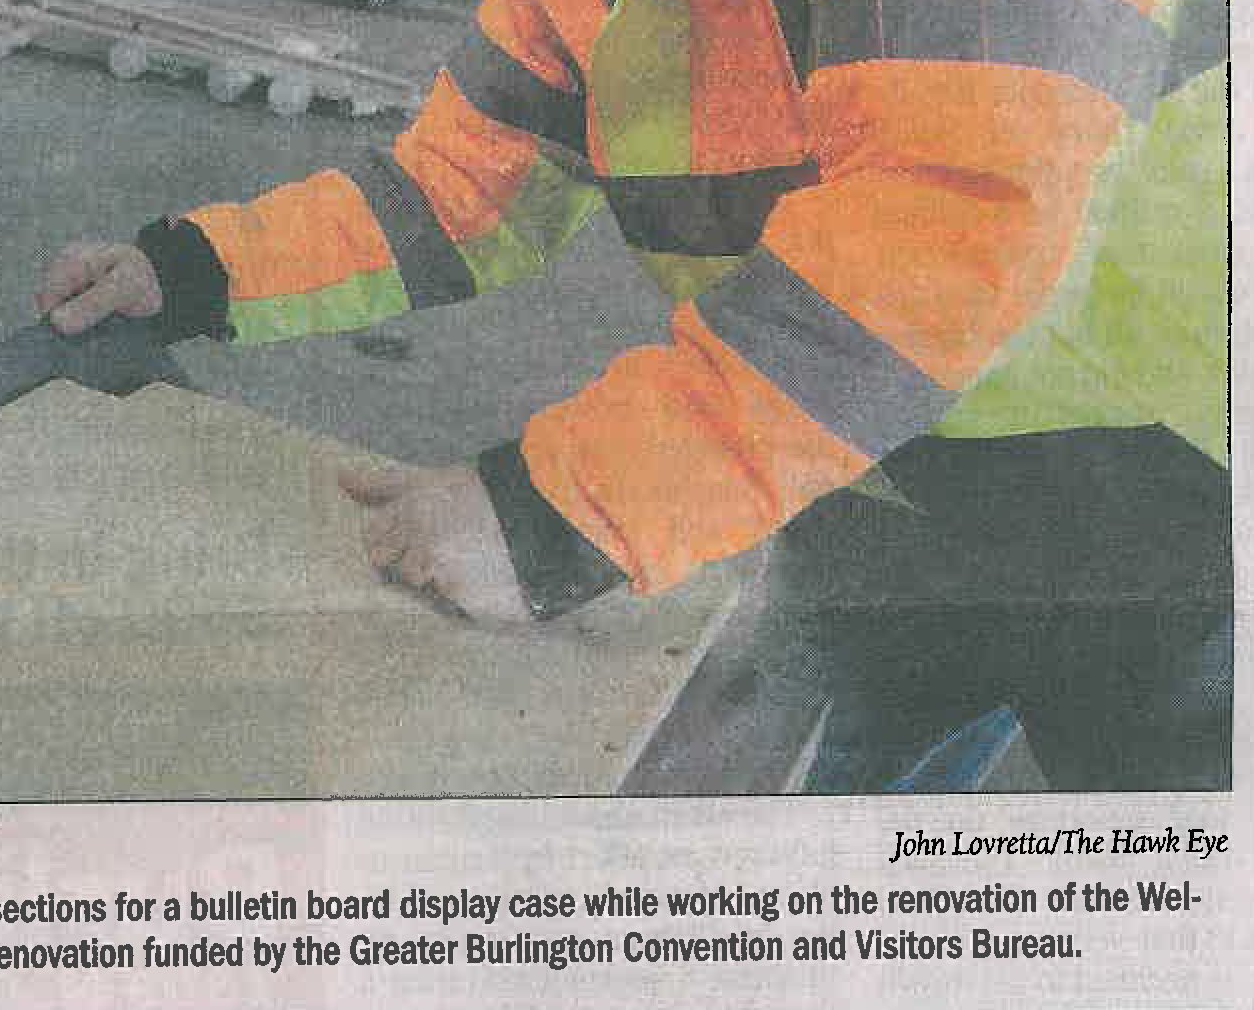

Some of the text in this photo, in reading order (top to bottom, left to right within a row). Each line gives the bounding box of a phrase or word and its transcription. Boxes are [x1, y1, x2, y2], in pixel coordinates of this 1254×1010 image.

[889, 827, 1228, 863] John Lovretta/The Hawk Eye
[115, 892, 156, 921] for
[164, 898, 180, 921] a
[191, 891, 296, 921] bulletin
[308, 889, 389, 919] board
[400, 889, 501, 925] display
[509, 894, 575, 918] case
[584, 887, 658, 916] while
[667, 886, 779, 922] working
[788, 892, 822, 915] on
[831, 885, 878, 914] the
[888, 883, 1036, 913] renovation
[1048, 882, 1076, 912] of
[1082, 882, 1129, 912] the
[1137, 881, 1201, 911] Wel-
[143, 936, 243, 967] funded
[254, 937, 286, 973] by
[293, 936, 340, 965] the
[350, 934, 458, 965] Greater
[467, 933, 613, 970] Burlington
[624, 931, 782, 962] Convention
[793, 930, 846, 960] and
[855, 930, 962, 959] Visitors
[973, 929, 1081, 958] Bureau.
